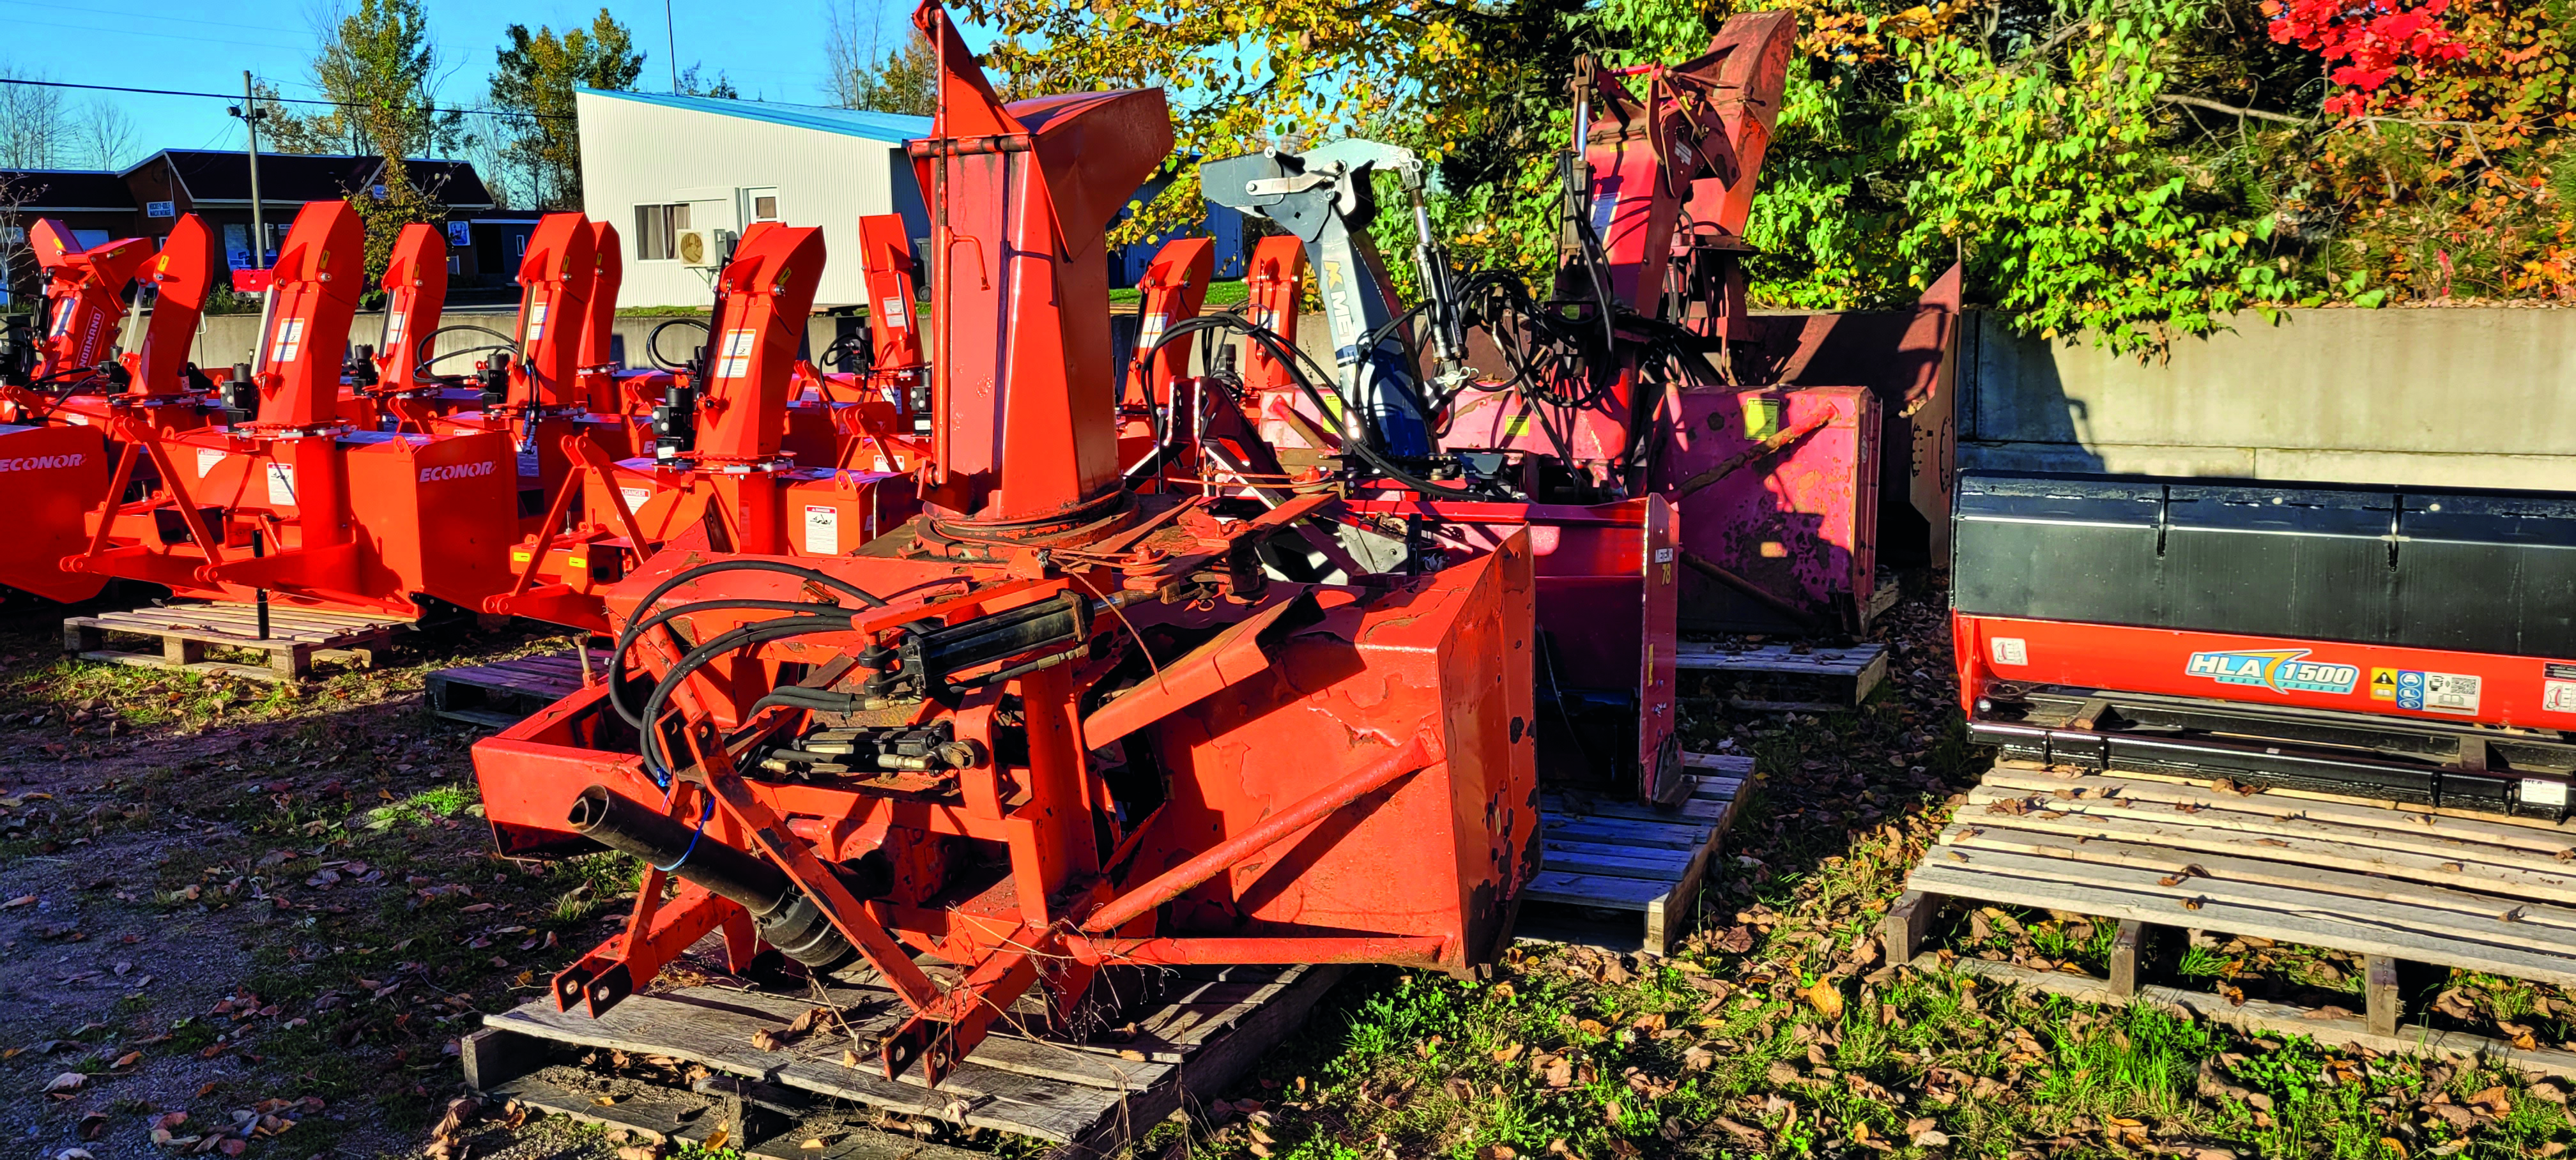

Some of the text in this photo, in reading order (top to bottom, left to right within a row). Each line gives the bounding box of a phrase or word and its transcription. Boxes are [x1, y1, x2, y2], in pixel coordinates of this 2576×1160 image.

[79, 312, 101, 368] NORMAND
[0, 454, 82, 472] ECONOR
[419, 461, 493, 482] ECONOR
[1662, 563, 1671, 585] 78
[2191, 655, 2356, 685] HLA 1500
